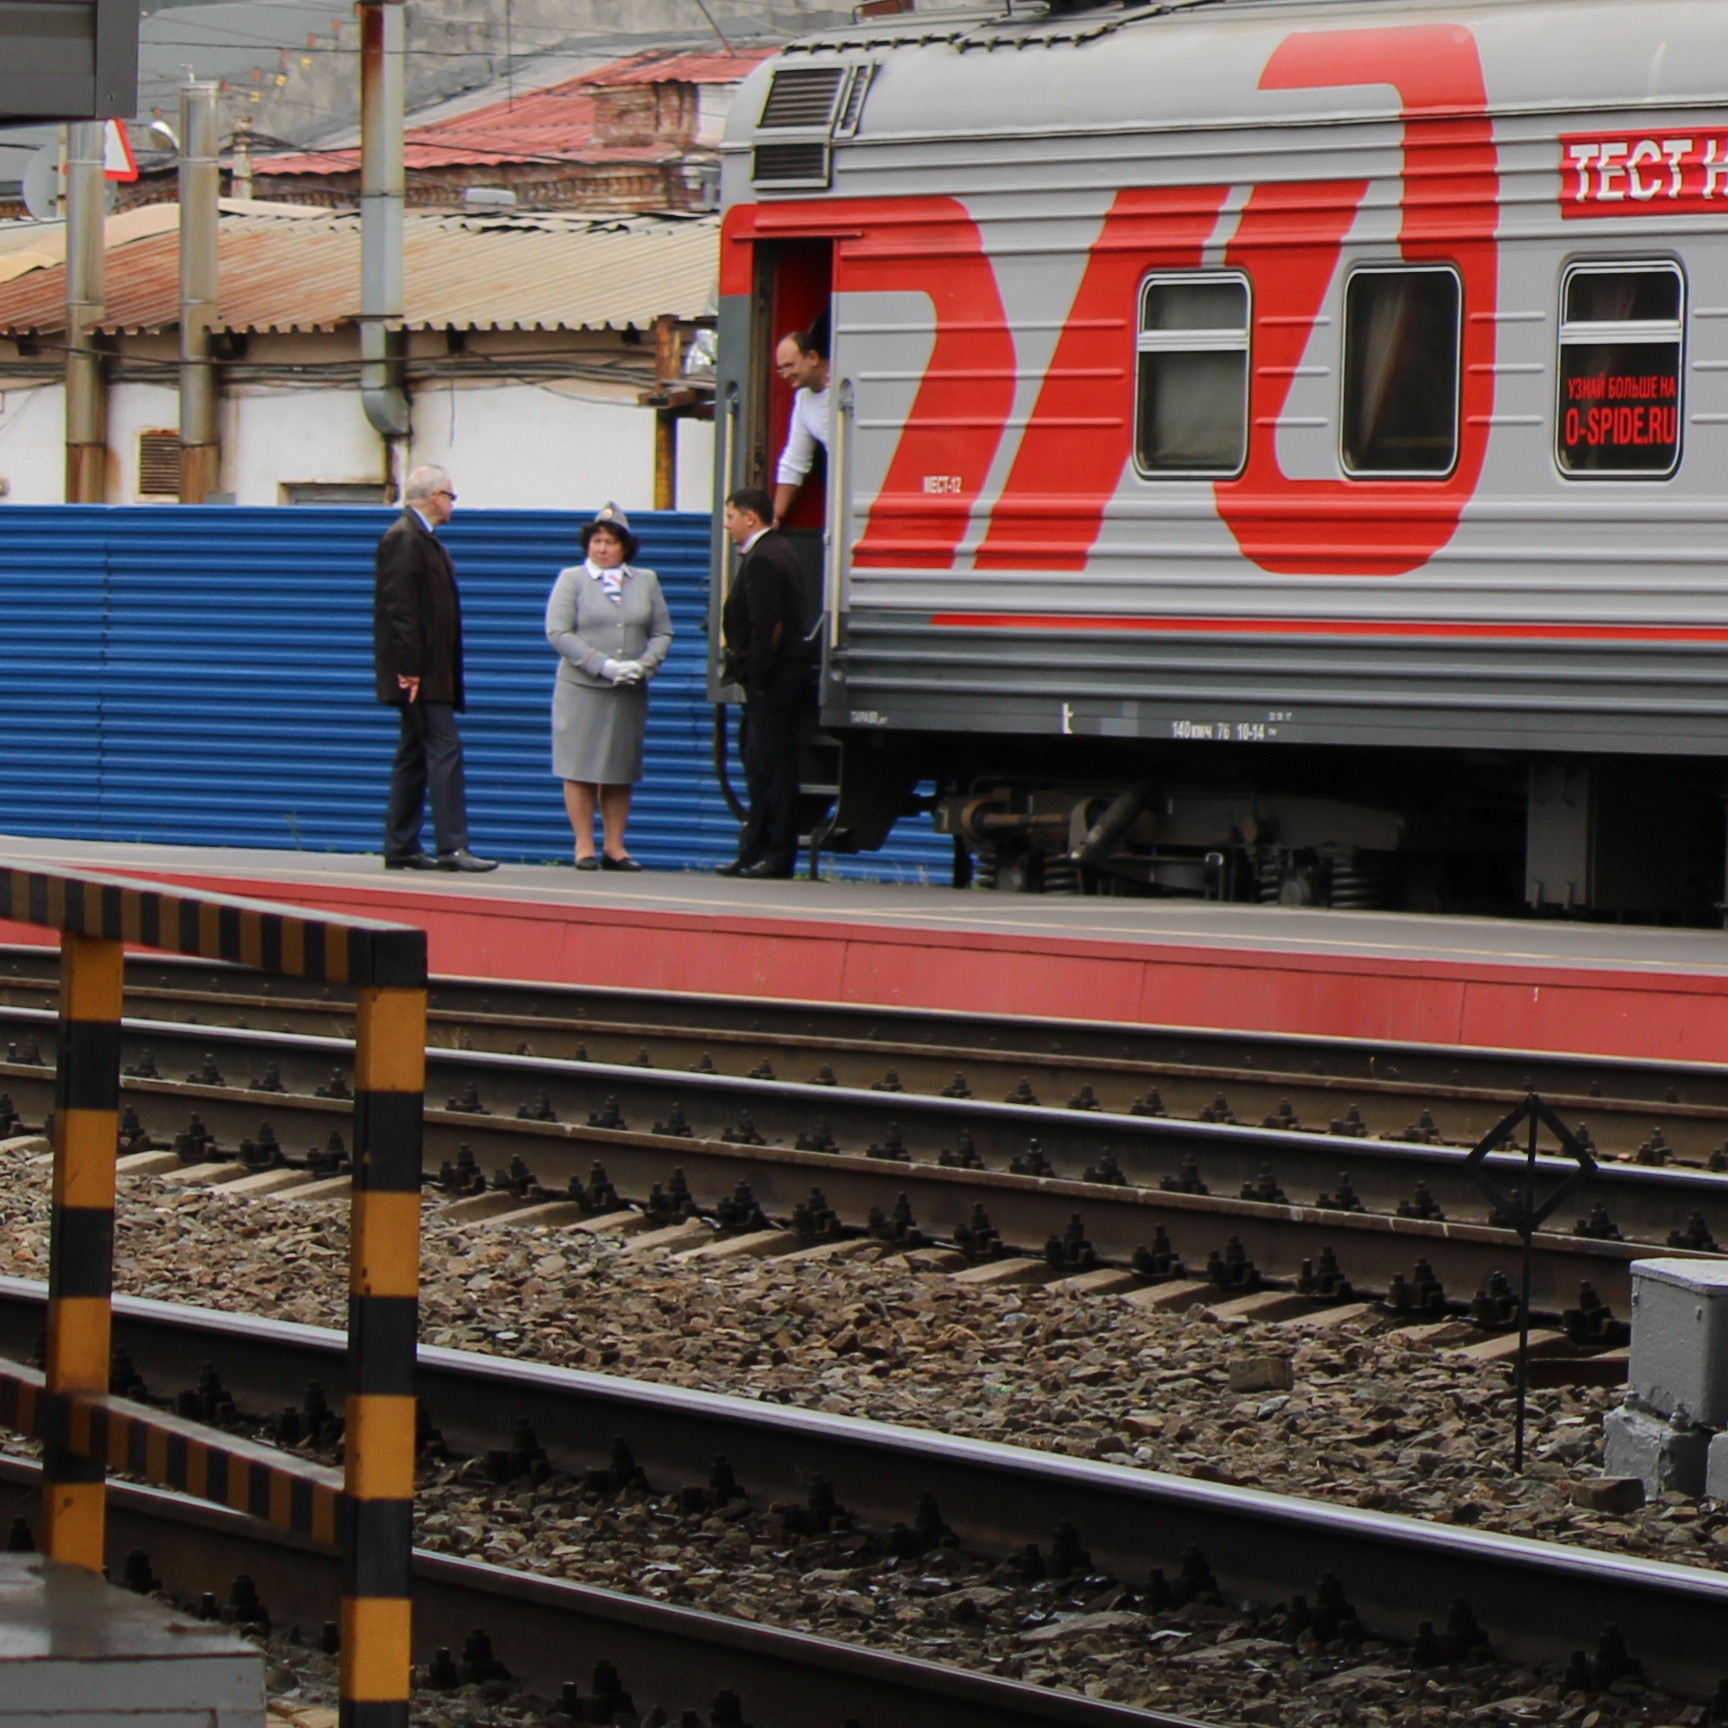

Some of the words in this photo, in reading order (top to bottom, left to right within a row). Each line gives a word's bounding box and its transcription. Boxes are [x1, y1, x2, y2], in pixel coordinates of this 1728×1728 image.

[1570, 139, 1692, 202] ТЕСТ
[1568, 372, 1606, 400] УЗНАЙ
[1608, 376, 1658, 399] БОЛЬШЕ
[1660, 376, 1677, 398] НА
